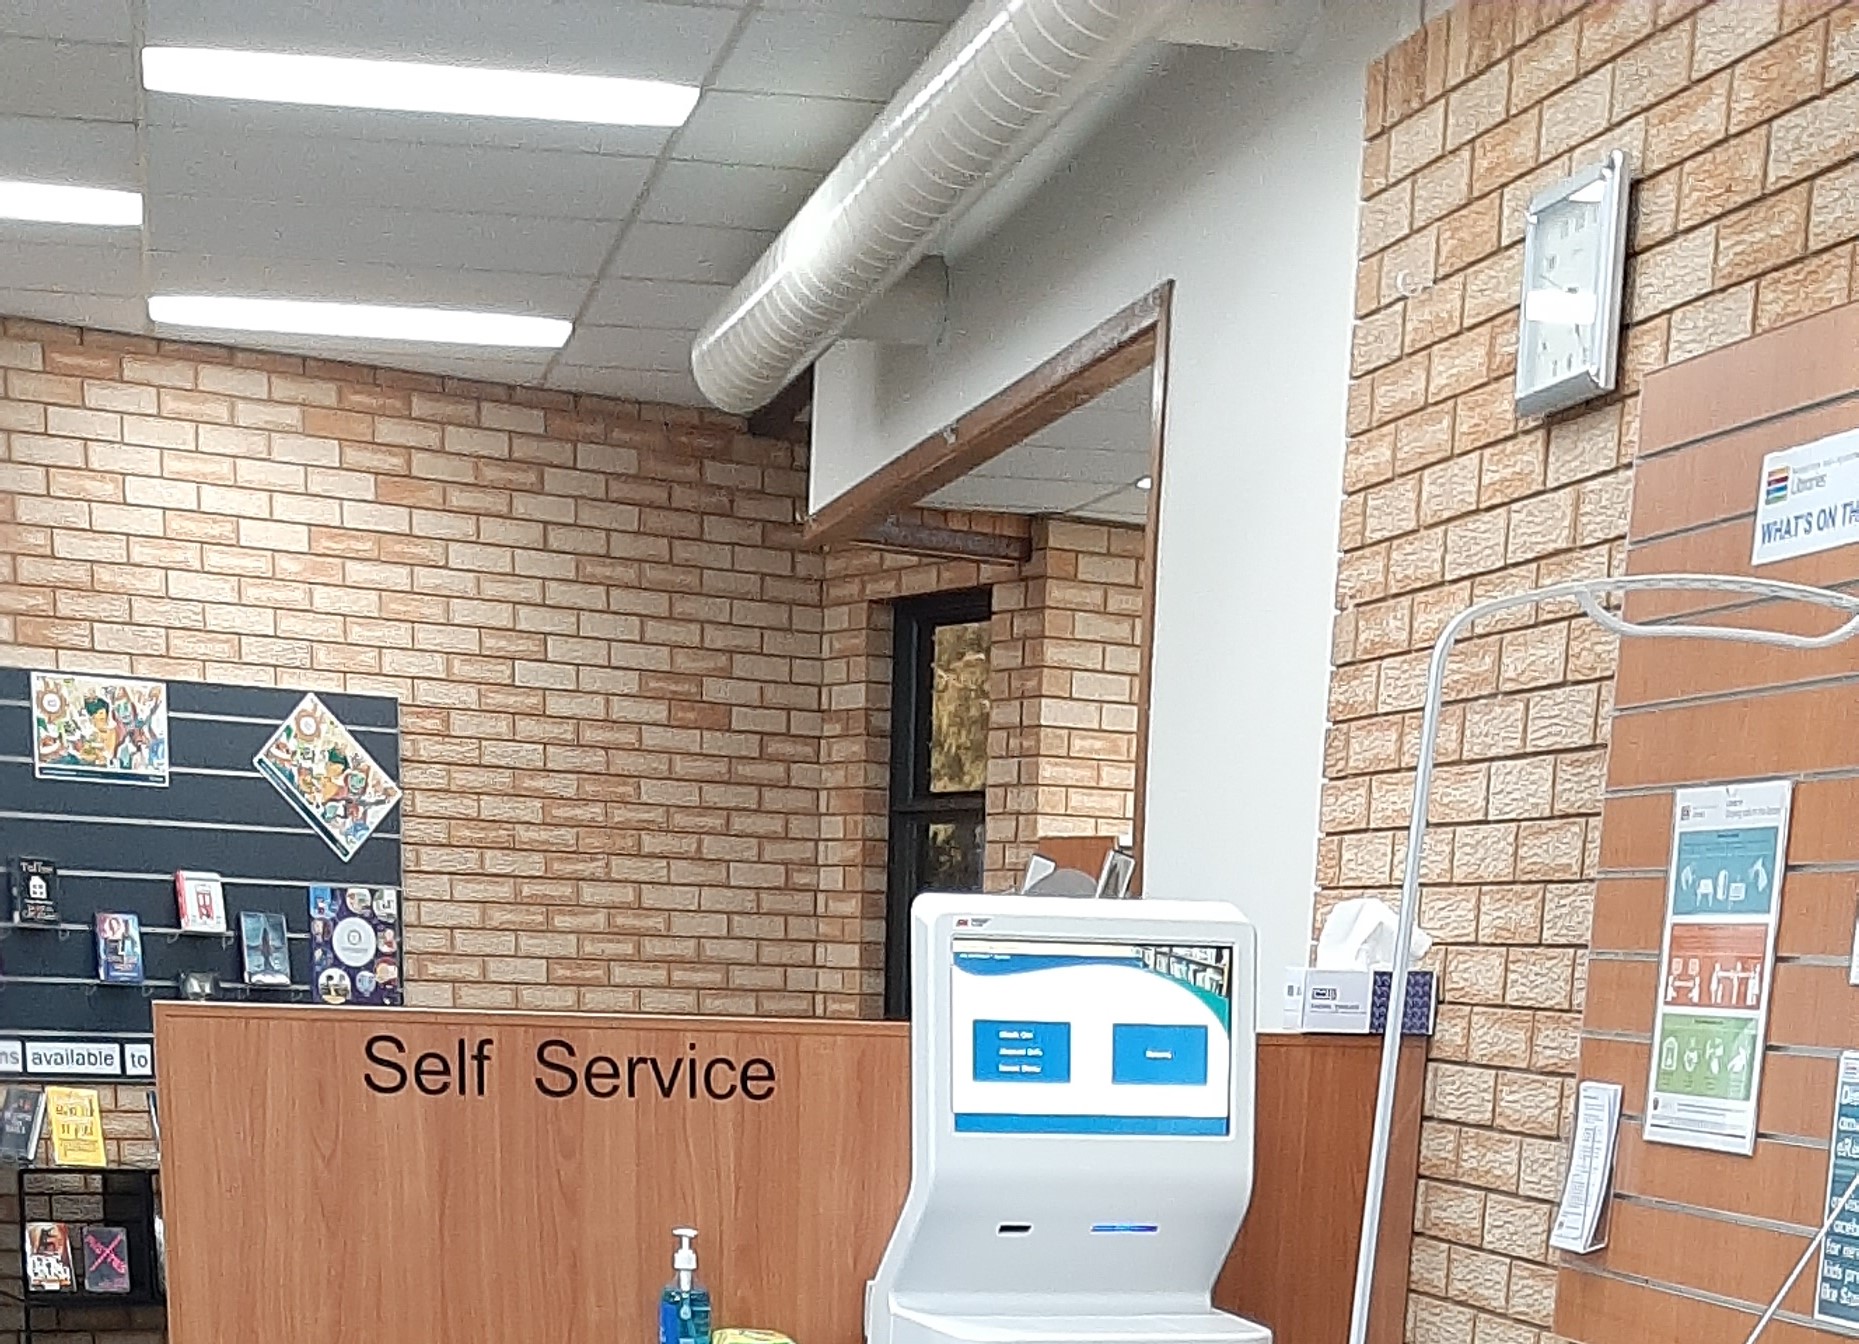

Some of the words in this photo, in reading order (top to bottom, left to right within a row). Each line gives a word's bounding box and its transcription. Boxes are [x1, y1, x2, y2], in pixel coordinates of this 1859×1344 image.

[1817, 504, 1838, 531] ON
[32, 1050, 115, 1067] available
[131, 1052, 148, 1068] to
[363, 1034, 494, 1097] Self
[535, 1038, 777, 1101] Service
